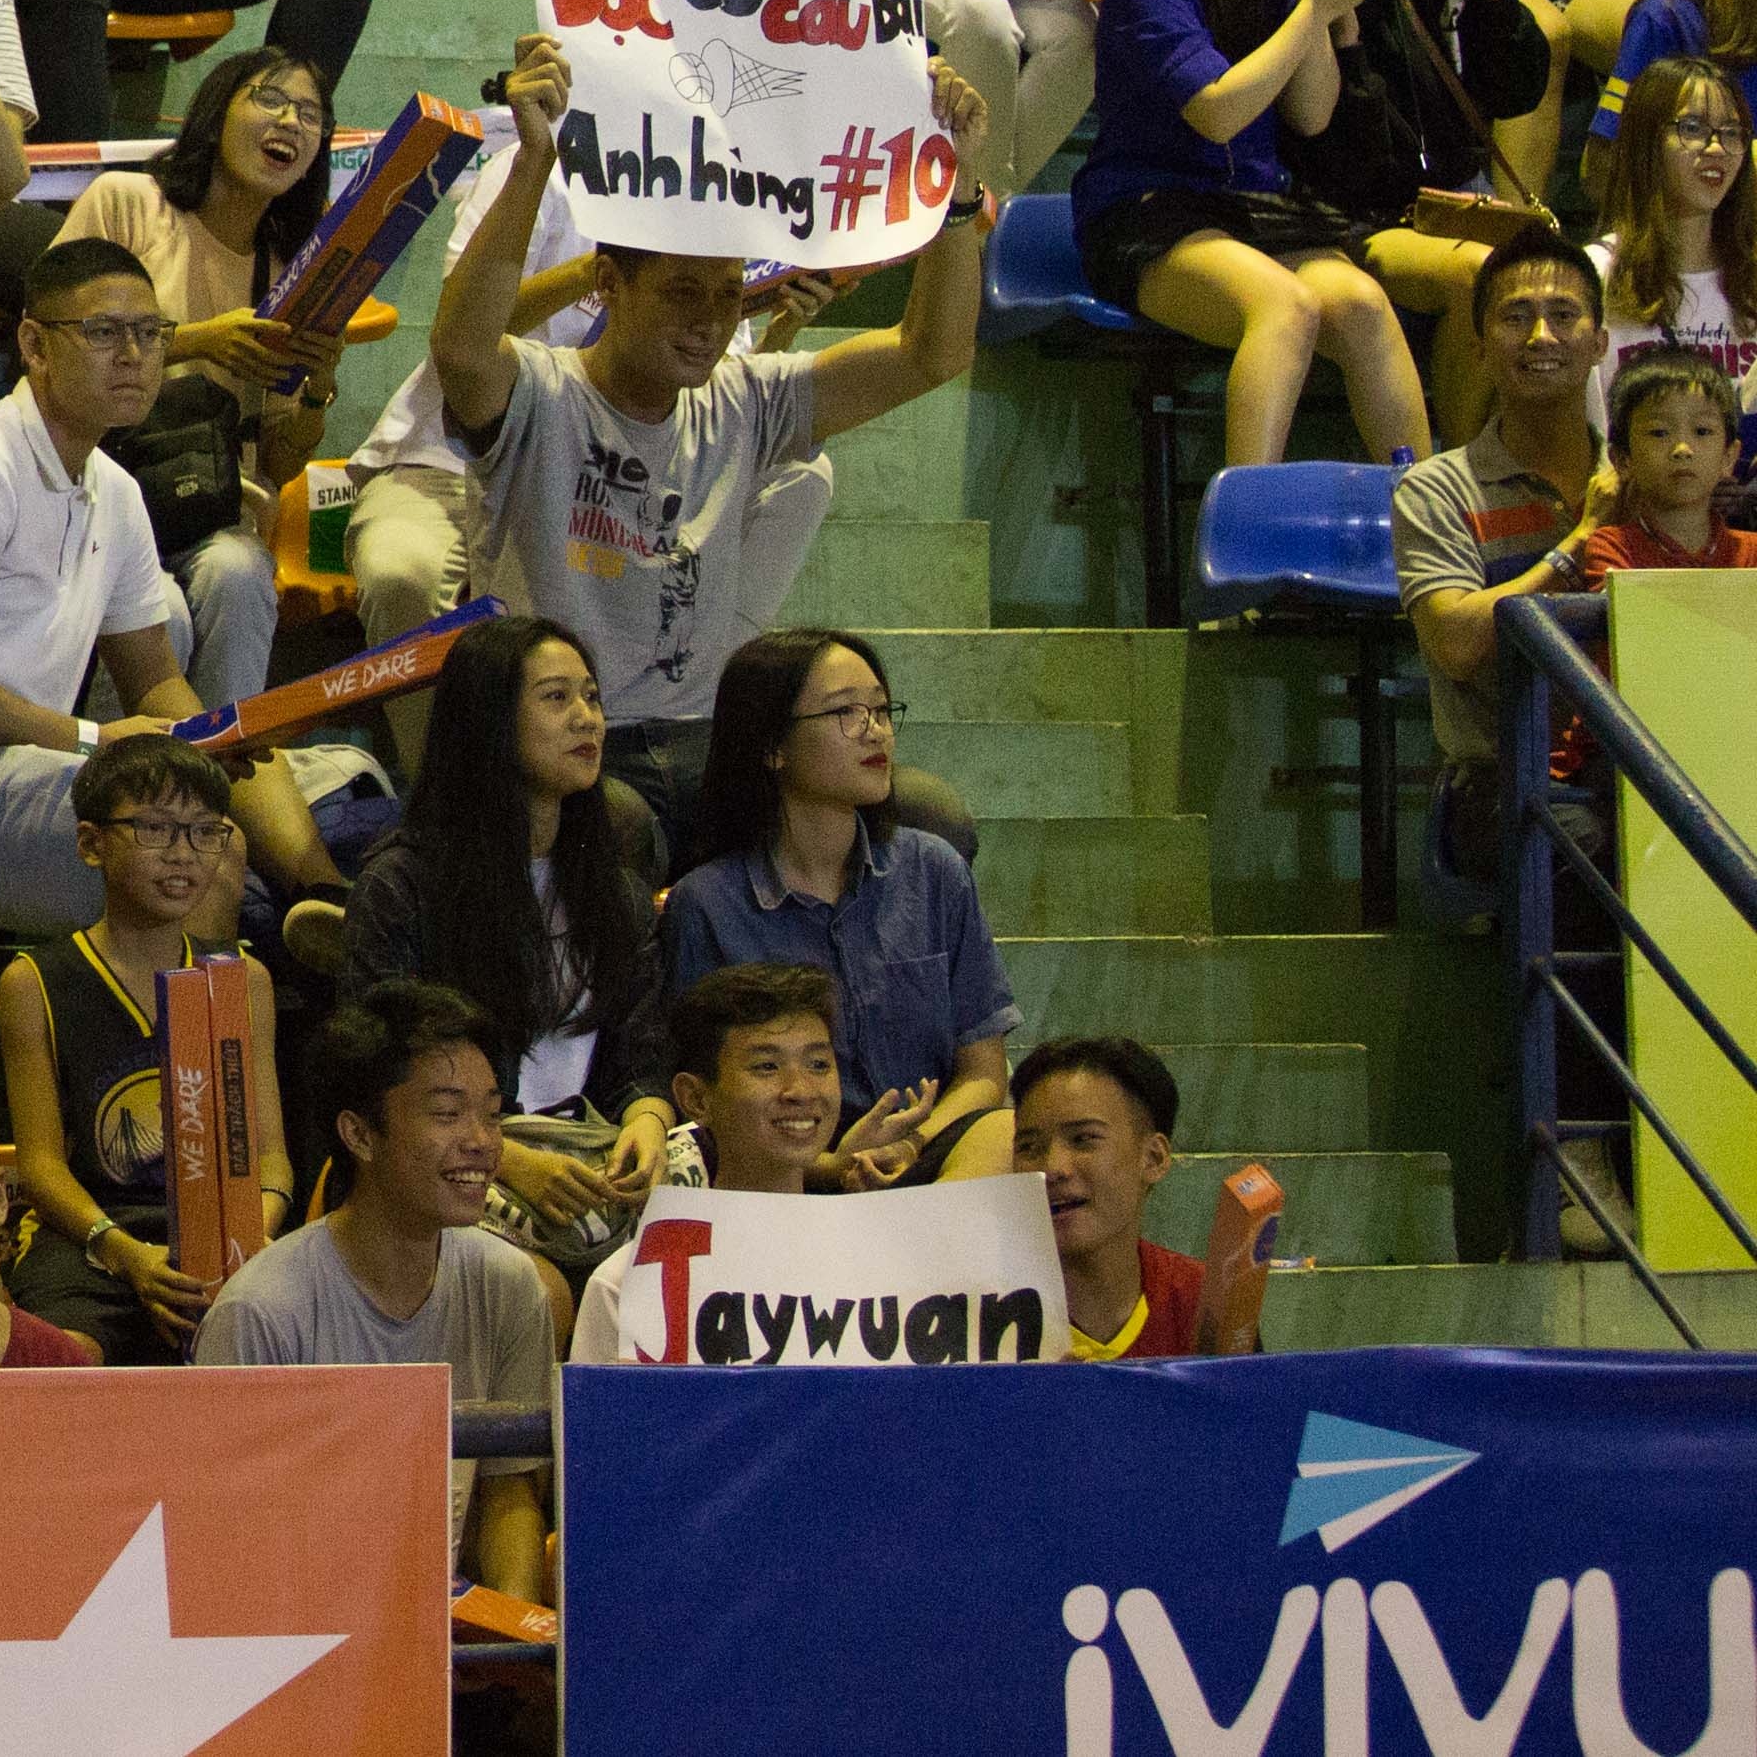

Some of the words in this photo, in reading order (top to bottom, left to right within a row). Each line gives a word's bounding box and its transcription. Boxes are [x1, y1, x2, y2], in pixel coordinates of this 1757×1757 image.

[555, 108, 682, 200] Anh
[690, 114, 815, 240] hùng
[820, 124, 959, 233] #10
[321, 669, 358, 699] WE
[363, 647, 418, 689] DARE
[180, 1064, 209, 1133] DARE
[183, 1139, 207, 1180] WE
